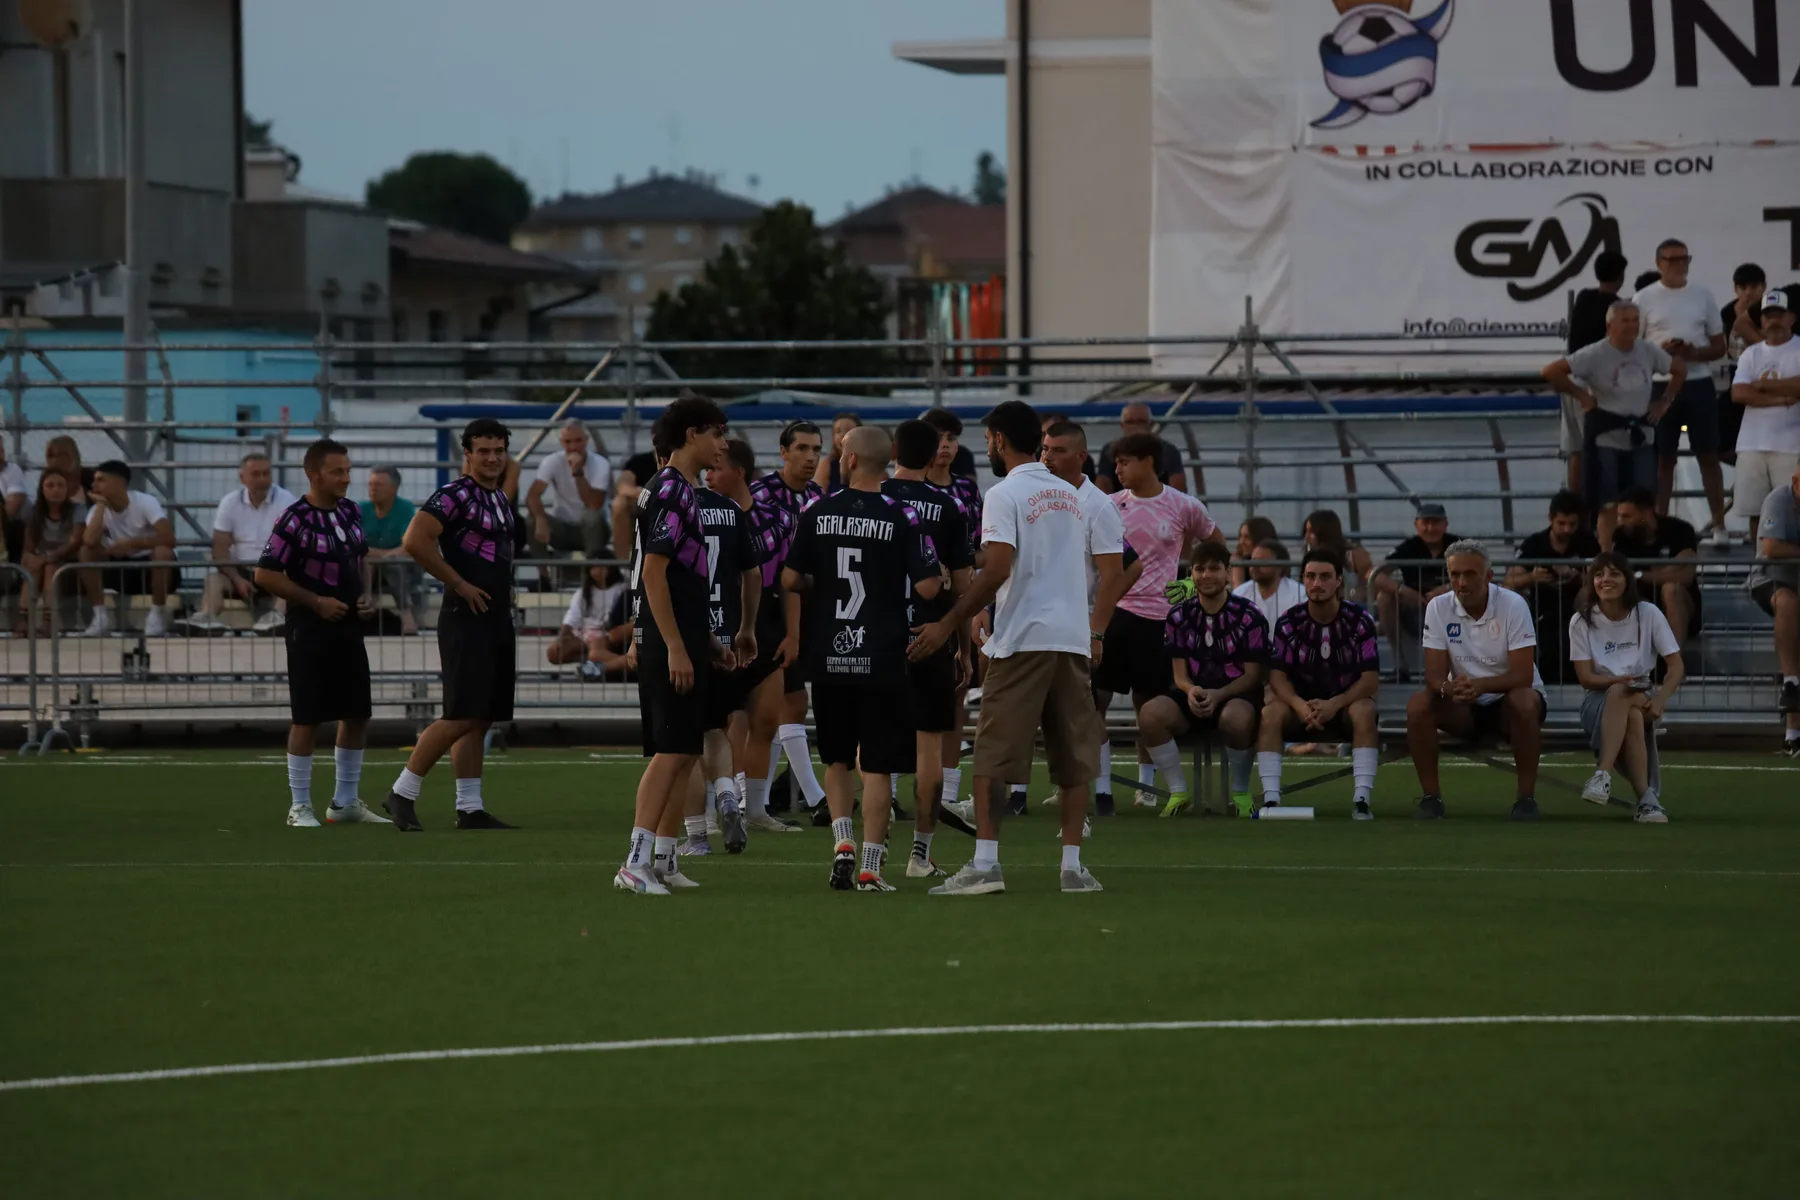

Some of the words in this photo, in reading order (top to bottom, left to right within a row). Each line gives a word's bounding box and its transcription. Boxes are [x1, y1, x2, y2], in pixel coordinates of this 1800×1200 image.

[1550, 0, 1800, 91] UN
[1366, 165, 1391, 181] IN
[1397, 158, 1646, 179] COLLABORAZIONE
[1654, 155, 1713, 175] CON
[1027, 488, 1079, 506] QUARTIERE
[816, 515, 894, 541] SCALASANTA
[835, 546, 867, 620] 5
